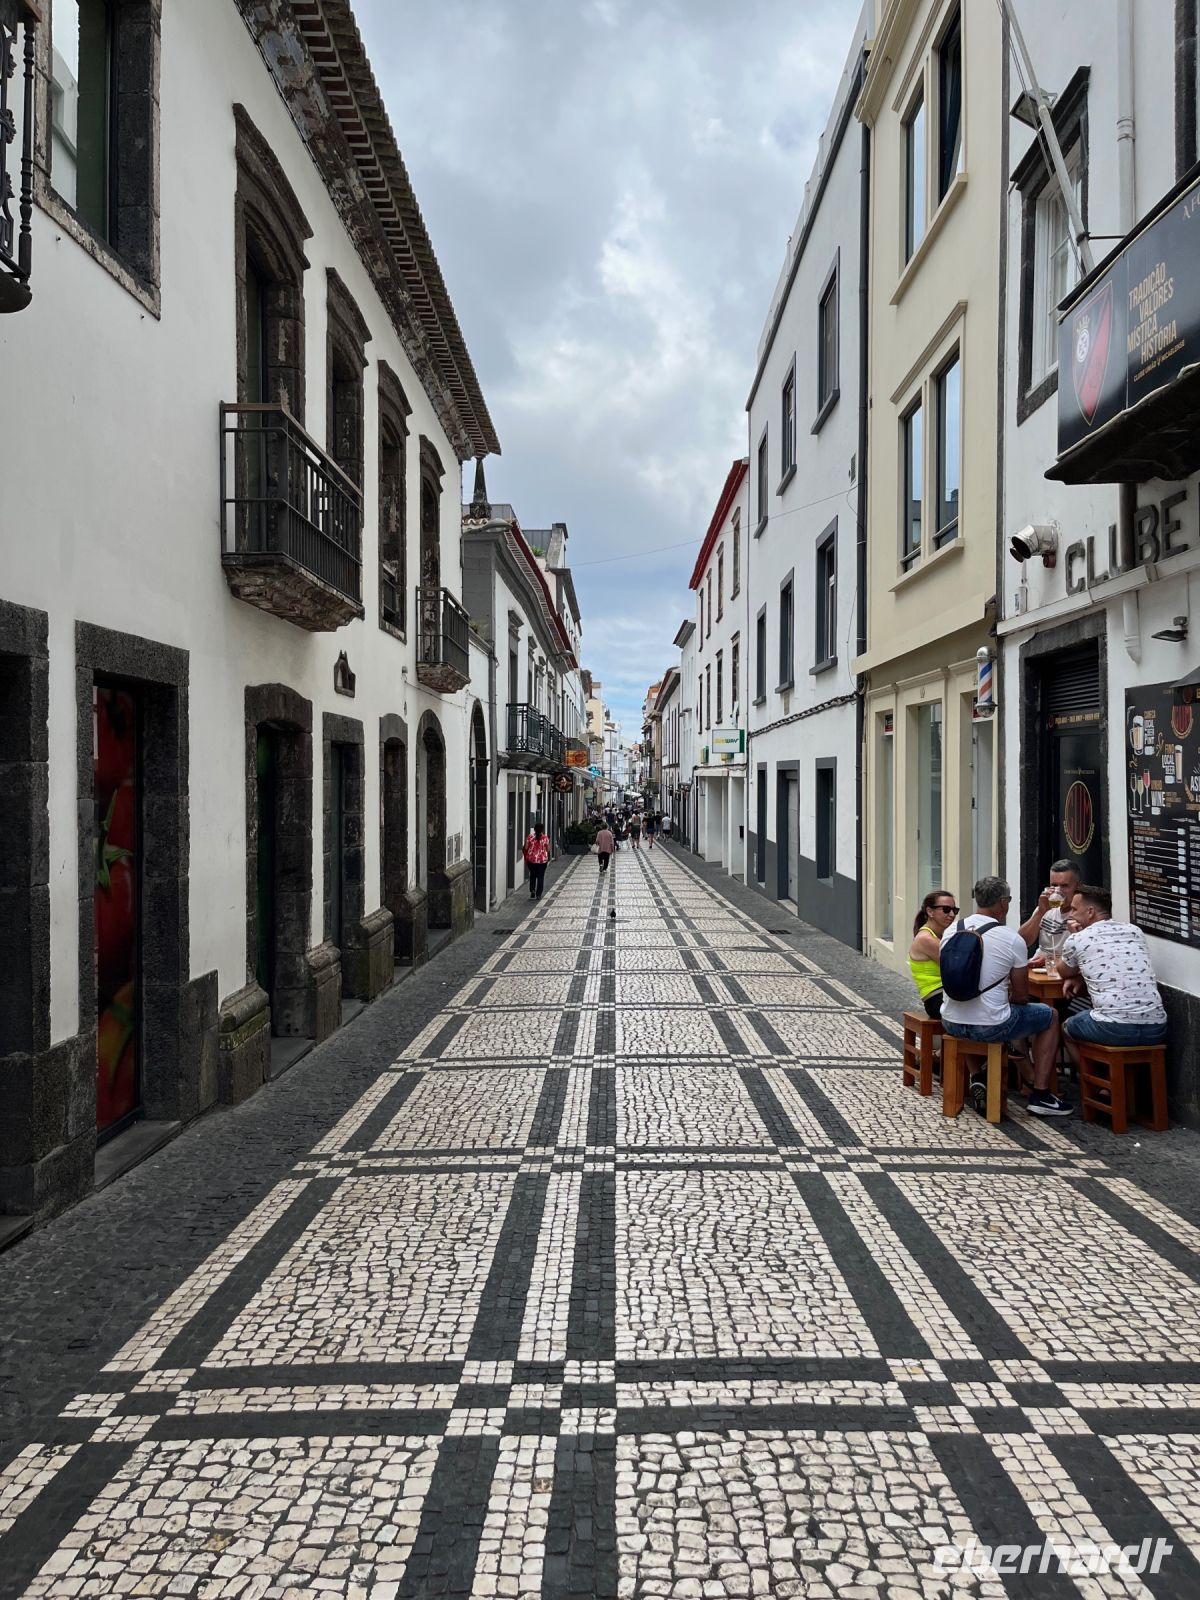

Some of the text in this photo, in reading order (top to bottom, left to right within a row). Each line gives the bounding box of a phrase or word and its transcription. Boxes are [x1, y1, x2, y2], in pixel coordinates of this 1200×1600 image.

[1129, 262, 1166, 311] TRADIÇÃO
[1140, 277, 1174, 322] VALORES
[1141, 319, 1177, 364] HISTÓRIA
